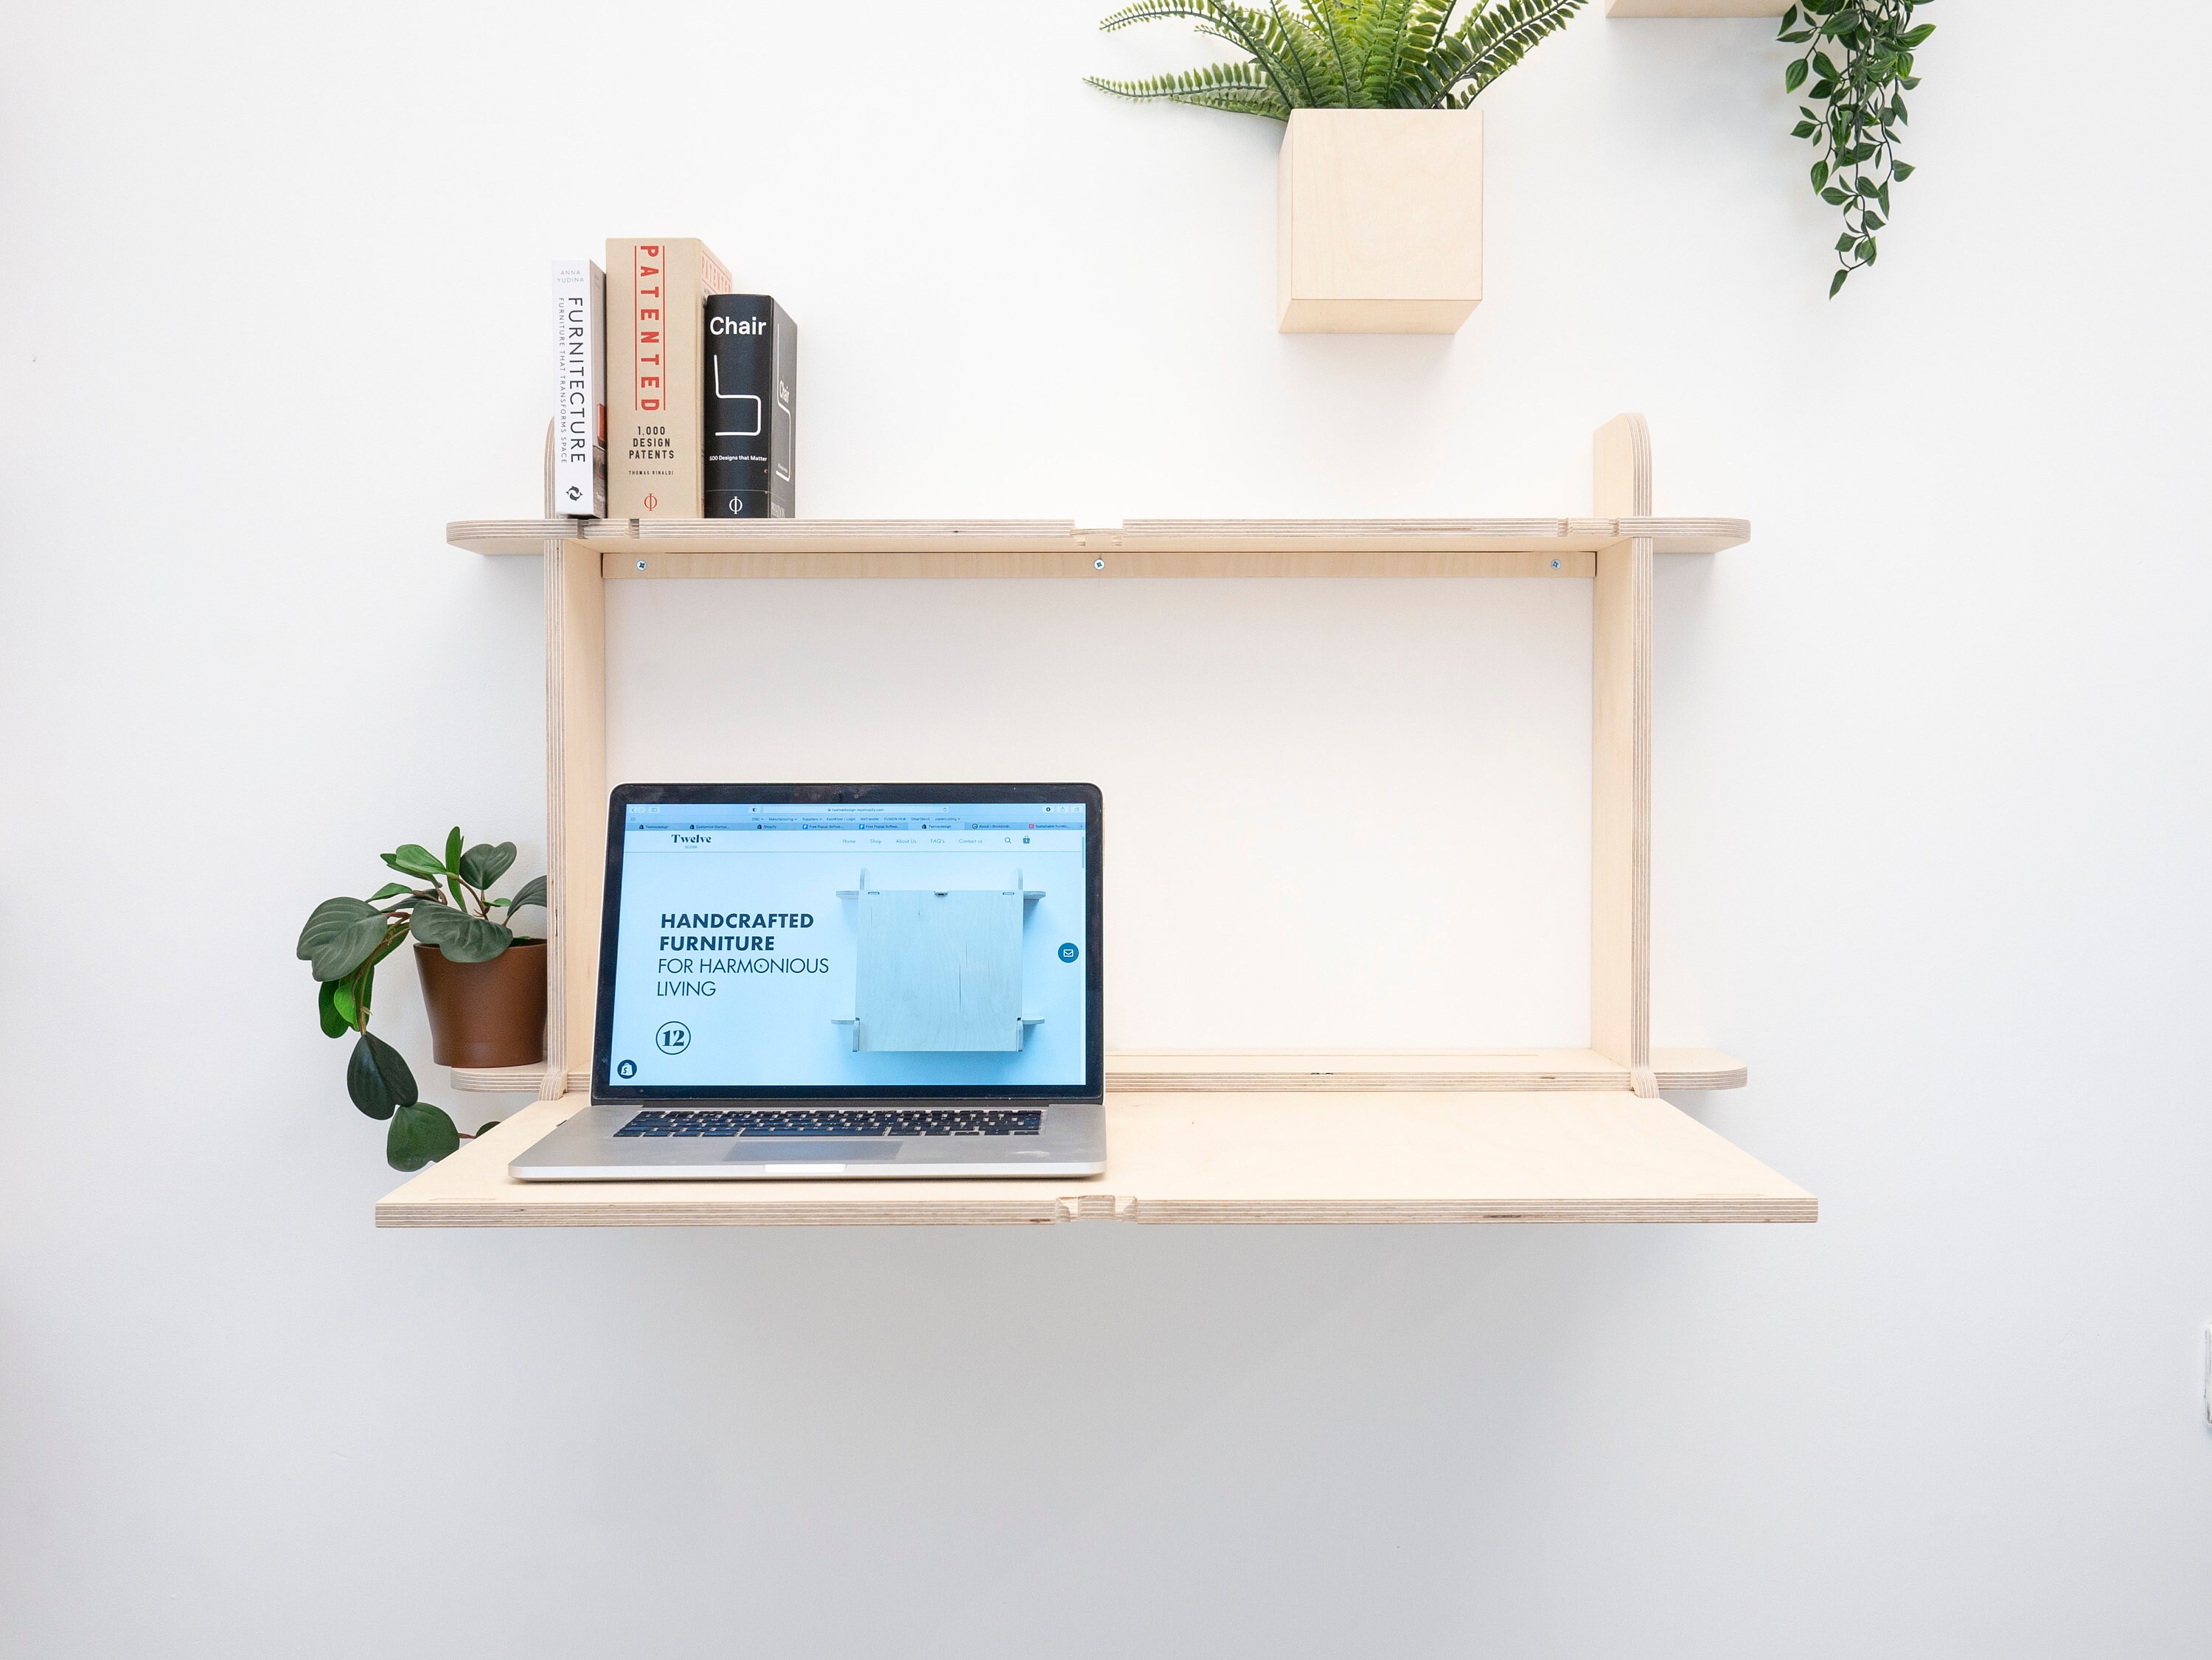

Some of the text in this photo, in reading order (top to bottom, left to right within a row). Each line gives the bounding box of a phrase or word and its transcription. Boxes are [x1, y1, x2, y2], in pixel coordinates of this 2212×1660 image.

[640, 245, 660, 411] PATENTED
[709, 316, 767, 335] Chair
[568, 297, 586, 463] FURNITECTURE
[779, 380, 790, 404] Chair
[633, 438, 670, 447] DESIGN
[629, 450, 675, 459] PATENTS
[671, 834, 712, 843] Twelve
[661, 913, 814, 929] HANDCRAFTED
[659, 935, 775, 951] FURNITURE
[658, 958, 830, 974] FOR HARMONIOUS
[657, 980, 717, 997] LIVING
[662, 1030, 685, 1047] 12
